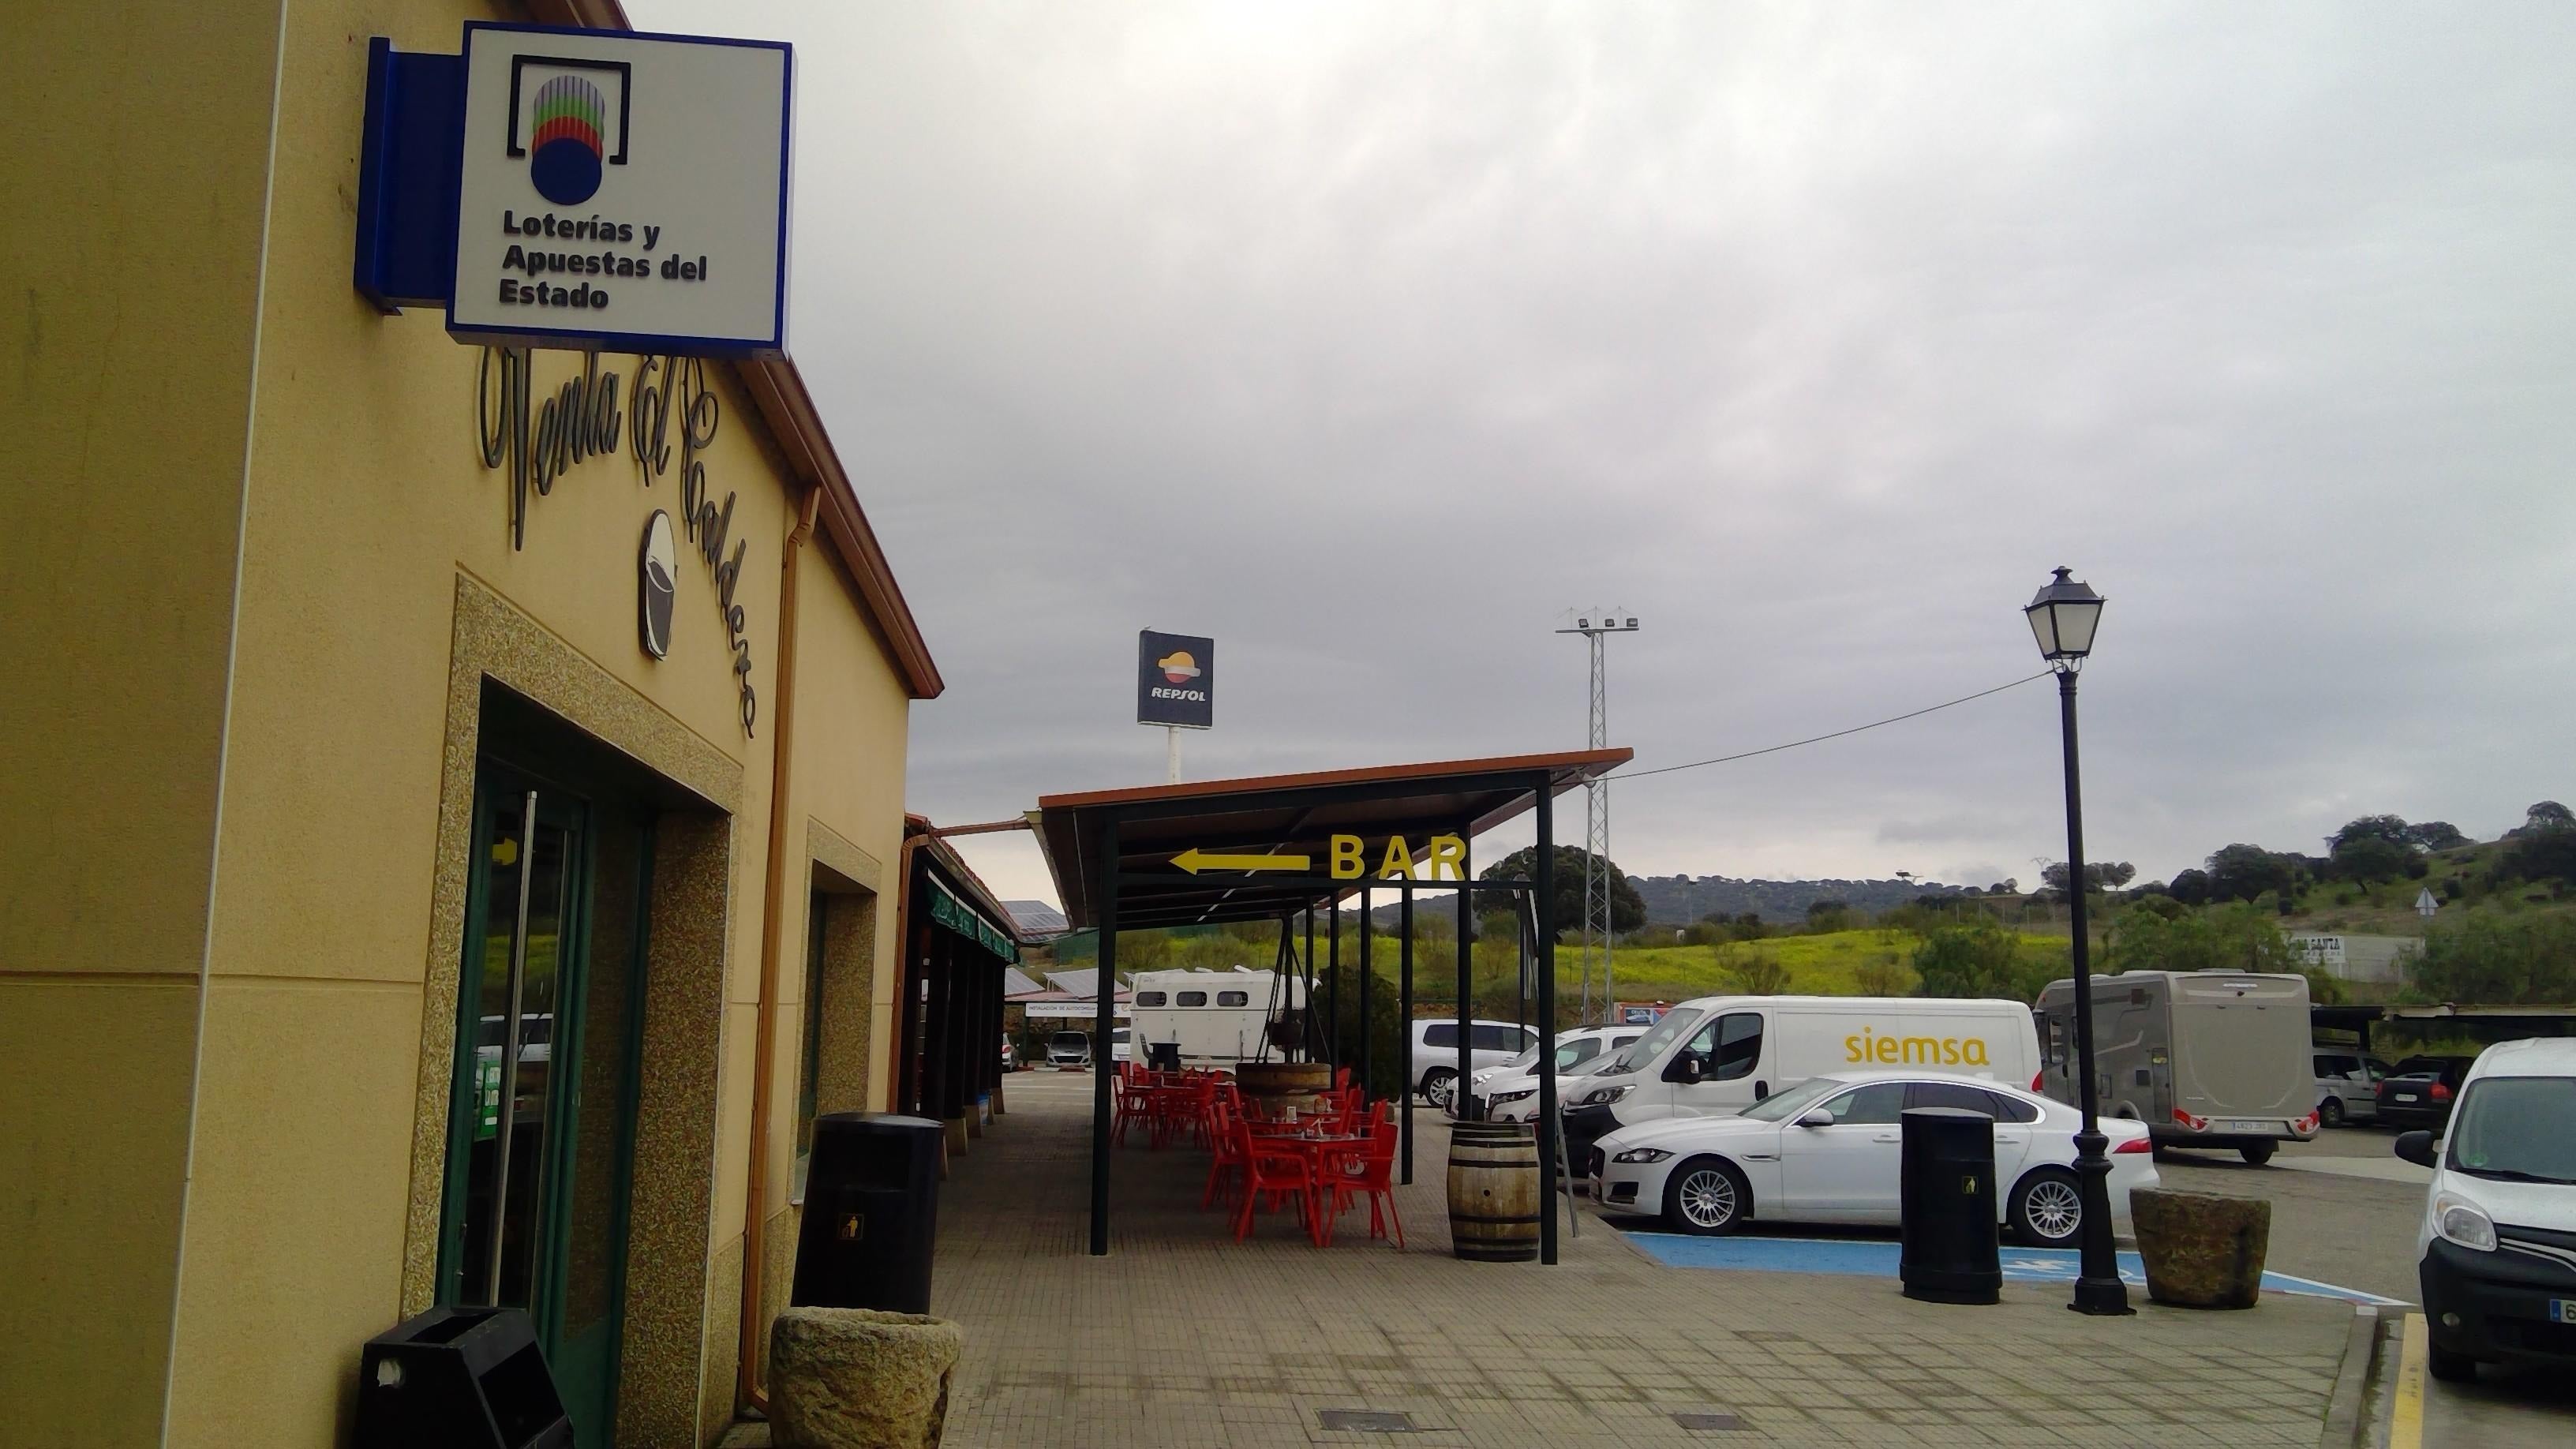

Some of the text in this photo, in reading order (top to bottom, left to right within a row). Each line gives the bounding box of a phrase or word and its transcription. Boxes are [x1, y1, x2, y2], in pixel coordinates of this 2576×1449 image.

[504, 210, 660, 251] Loterías y
[502, 245, 707, 280] Apuestas del
[499, 279, 608, 309] Estado
[1151, 687, 1206, 702] REPSOL
[1331, 833, 1467, 882] BAR
[1845, 1026, 1990, 1066] siemsa
